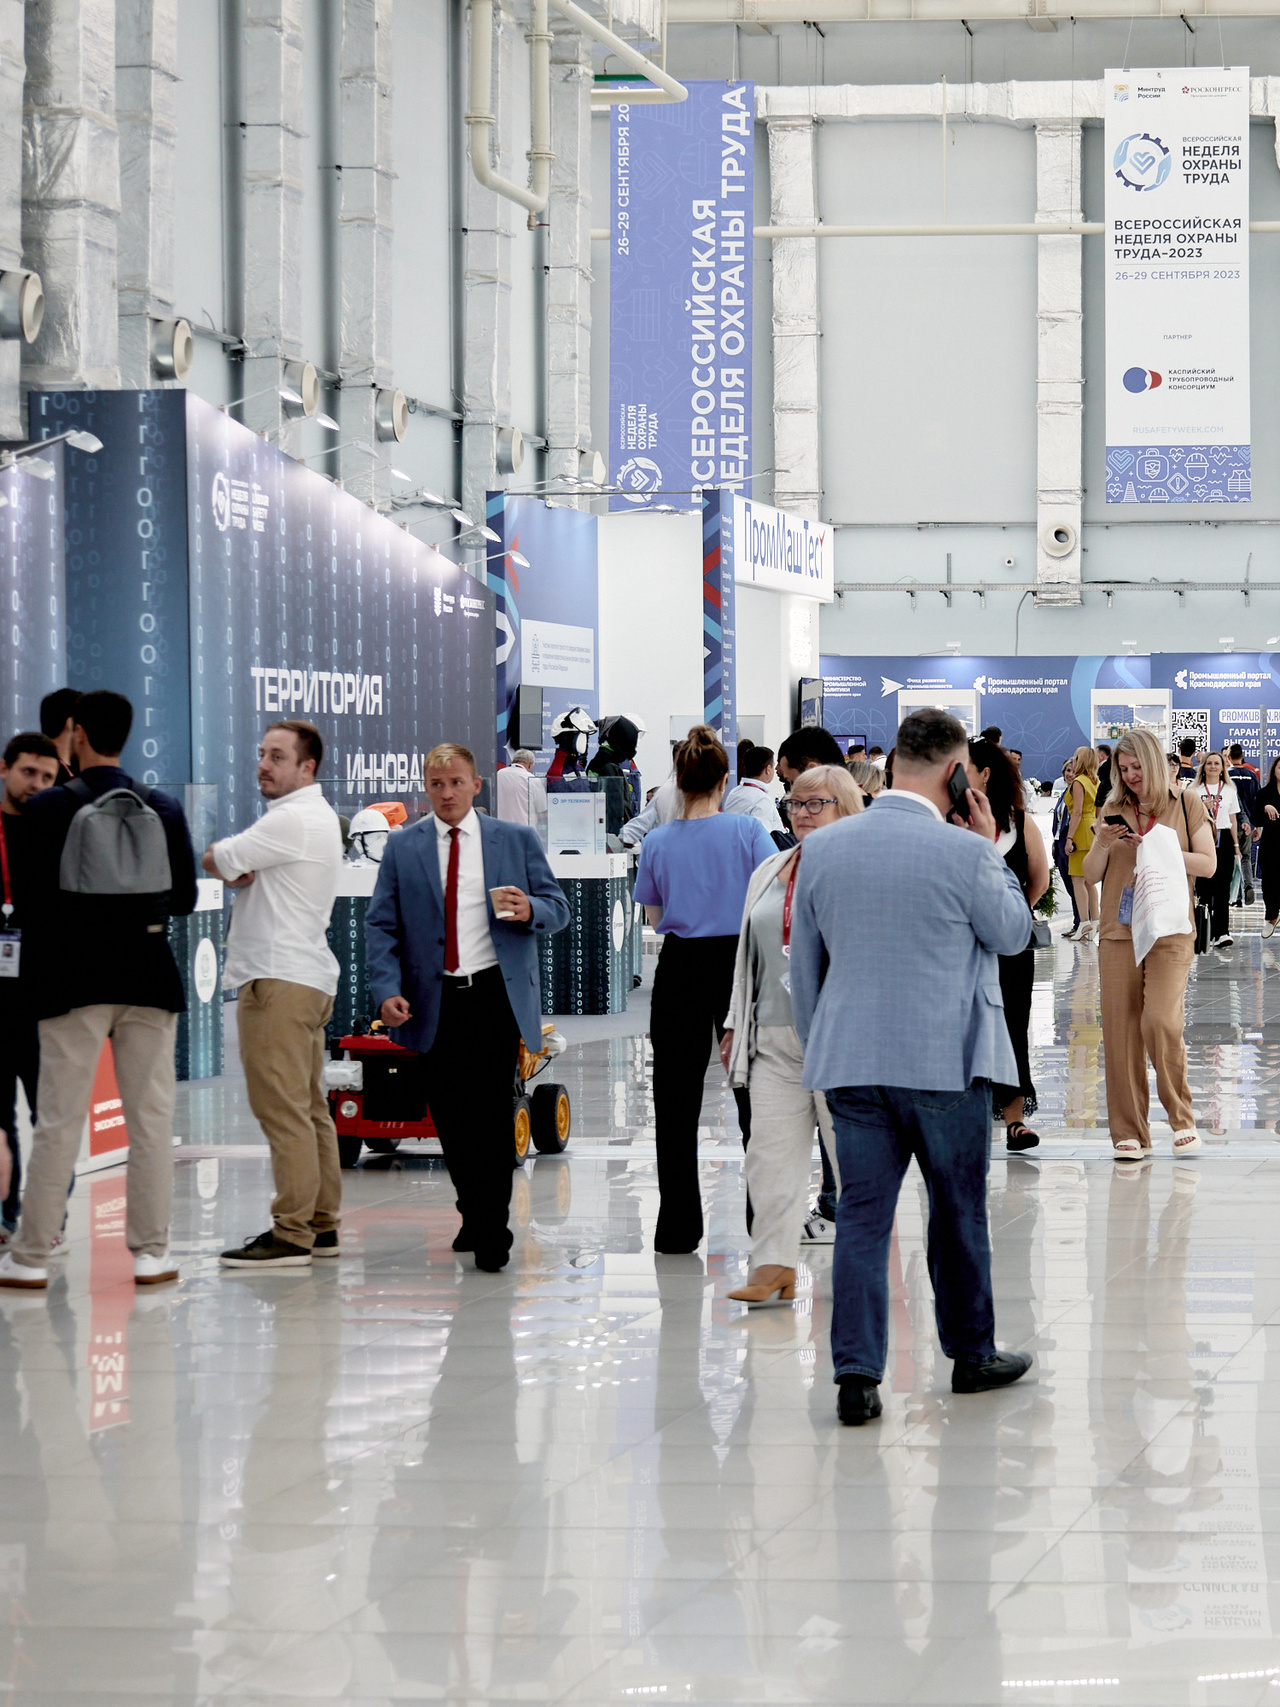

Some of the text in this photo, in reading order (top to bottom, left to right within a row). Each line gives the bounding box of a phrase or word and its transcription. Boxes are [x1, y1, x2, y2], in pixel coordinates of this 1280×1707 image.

[720, 86, 751, 198] ТРУДА
[1182, 145, 1240, 158] НЕДЕЛЯ
[617, 126, 630, 208] СЕНТЯБРЯ
[1182, 159, 1242, 170] ОХРАНЫ
[1183, 173, 1230, 186] ТРУДА
[1114, 216, 1242, 230] ВСЕРОССИЙСКАЯ
[617, 213, 630, 256] 26-29
[1114, 233, 1237, 246] НЕДЕЛЯ ОХРАНЫ
[1114, 248, 1203, 261] ТРУДА-2023
[1115, 270, 1240, 280] 26-29 СЕНТЯБРЯ 2023
[720, 210, 745, 356] ОХРАНЫ
[627, 405, 637, 450] НЕДЕЛЯ
[638, 403, 647, 450] ОХРАНЫ
[648, 412, 659, 450] ТРУДА
[1132, 426, 1224, 434] RUSAFETYWEEK.COM
[744, 502, 825, 581] ПромМашТест
[987, 677, 1068, 687] Промышленный портал
[1189, 671, 1272, 681] Промышленный портал
[987, 686, 1041, 695] Краснодарского
[1189, 680, 1244, 689] Краснодарского
[251, 667, 383, 716] ТЕРРИТОРИЯ
[346, 753, 426, 795] ИННОВА
